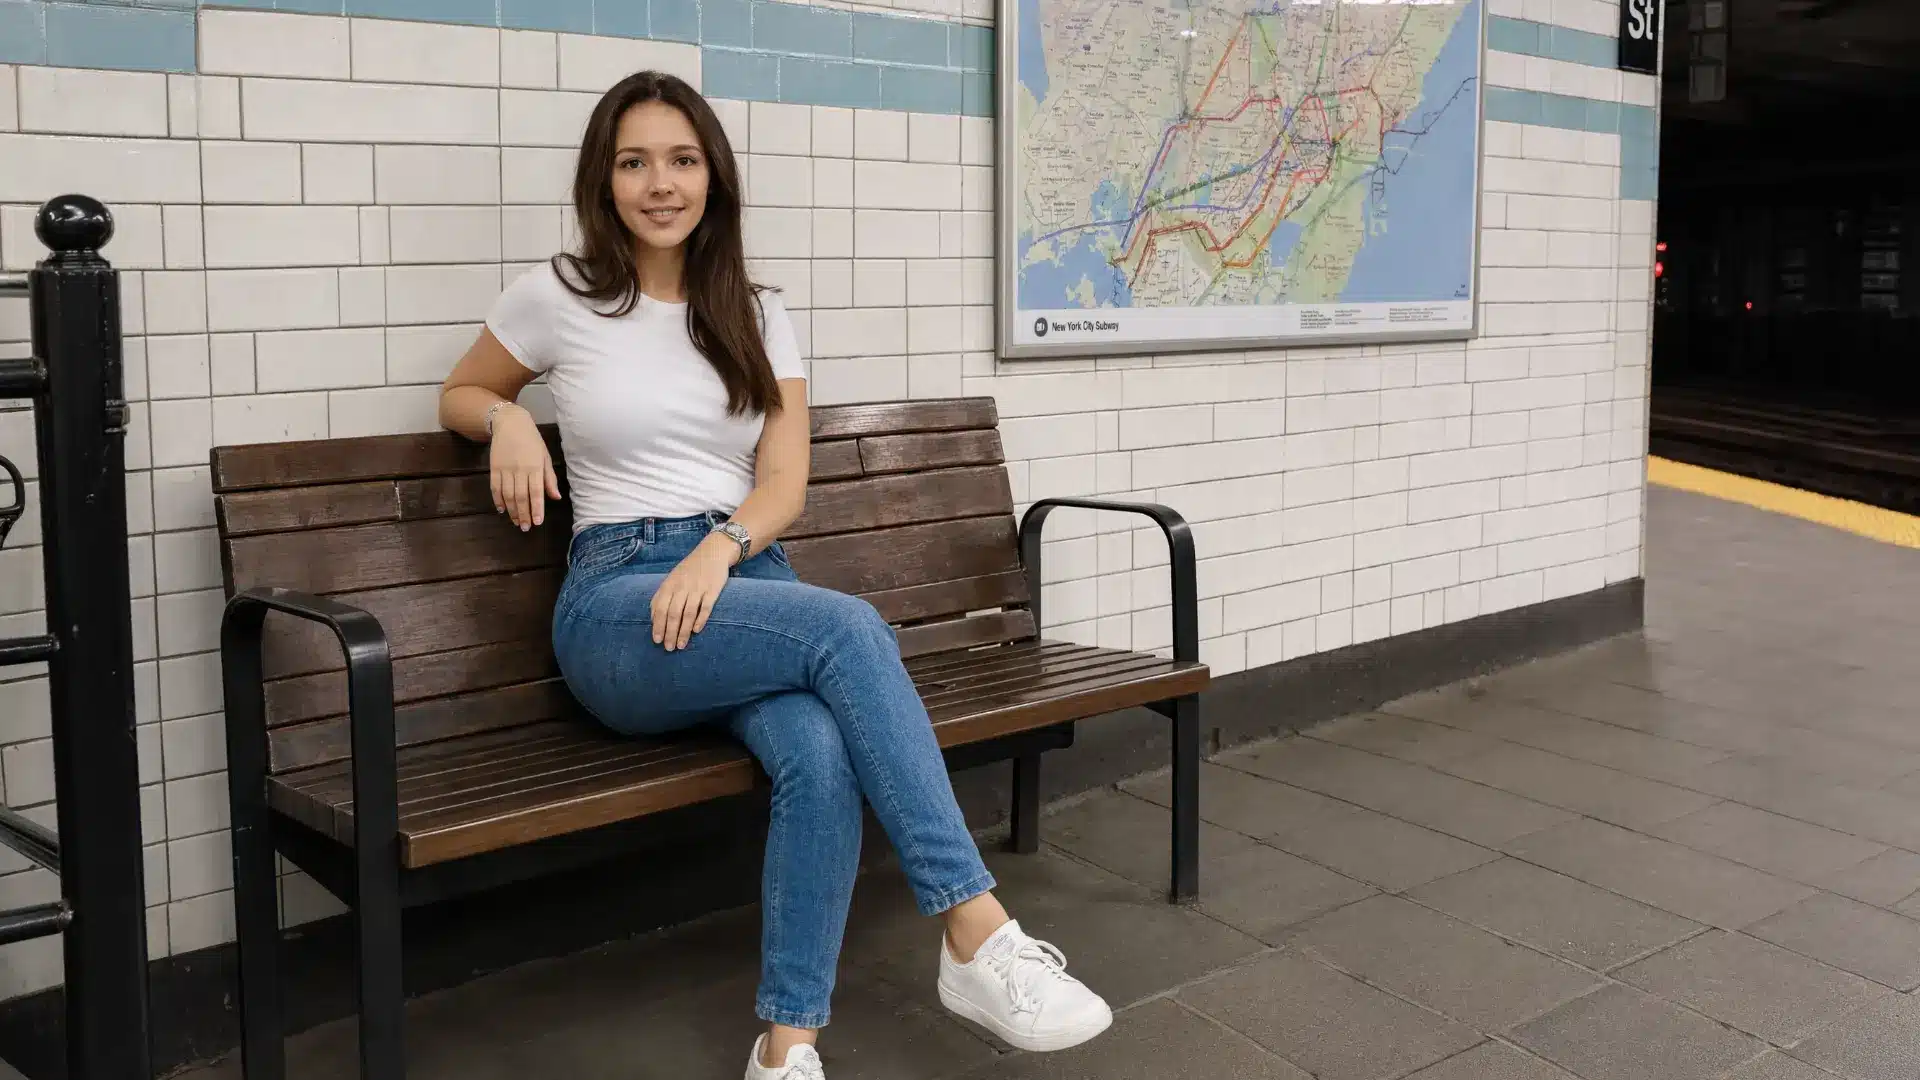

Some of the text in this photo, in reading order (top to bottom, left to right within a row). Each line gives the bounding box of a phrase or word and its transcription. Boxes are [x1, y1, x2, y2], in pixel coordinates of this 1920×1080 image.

[1628, 0, 1654, 40] St
[1052, 322, 1066, 332] New
[1067, 321, 1081, 331] York
[1083, 320, 1094, 332] City
[1095, 320, 1119, 332] Subway
